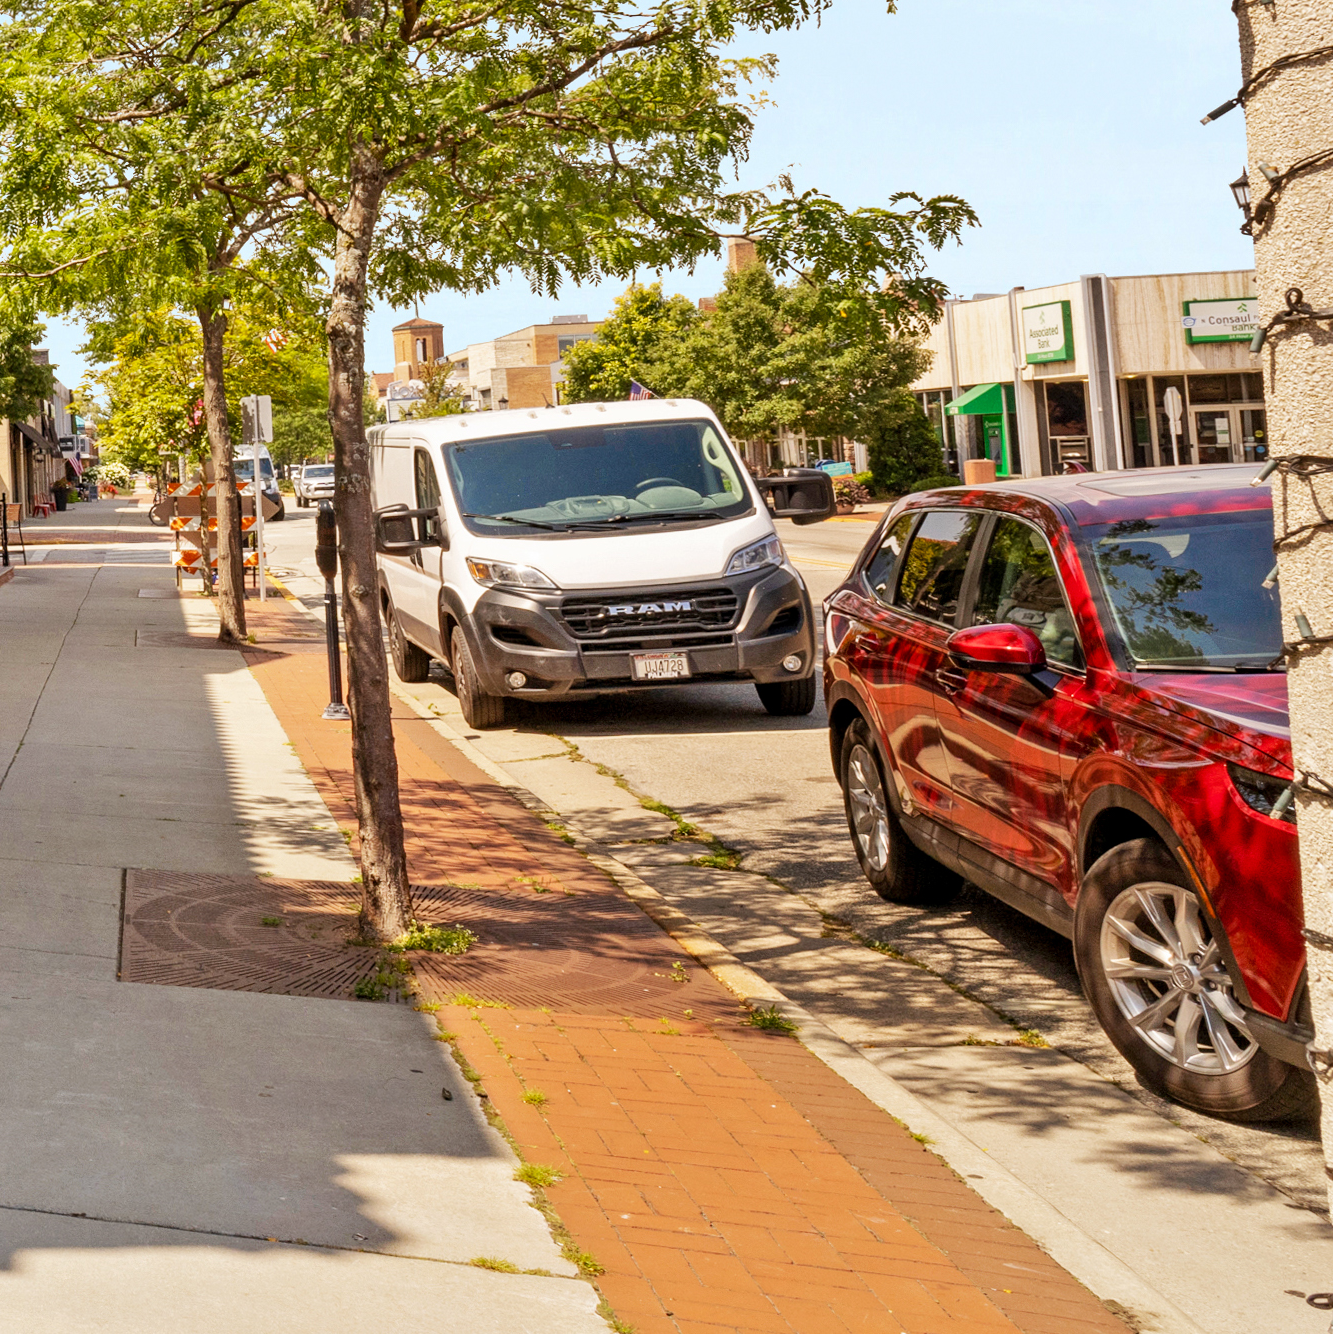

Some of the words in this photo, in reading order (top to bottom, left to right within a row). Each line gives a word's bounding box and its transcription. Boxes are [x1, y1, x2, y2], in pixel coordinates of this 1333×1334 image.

[1208, 313, 1251, 325] Consaul
[1029, 324, 1058, 338] Associated
[609, 601, 692, 616] RAM
